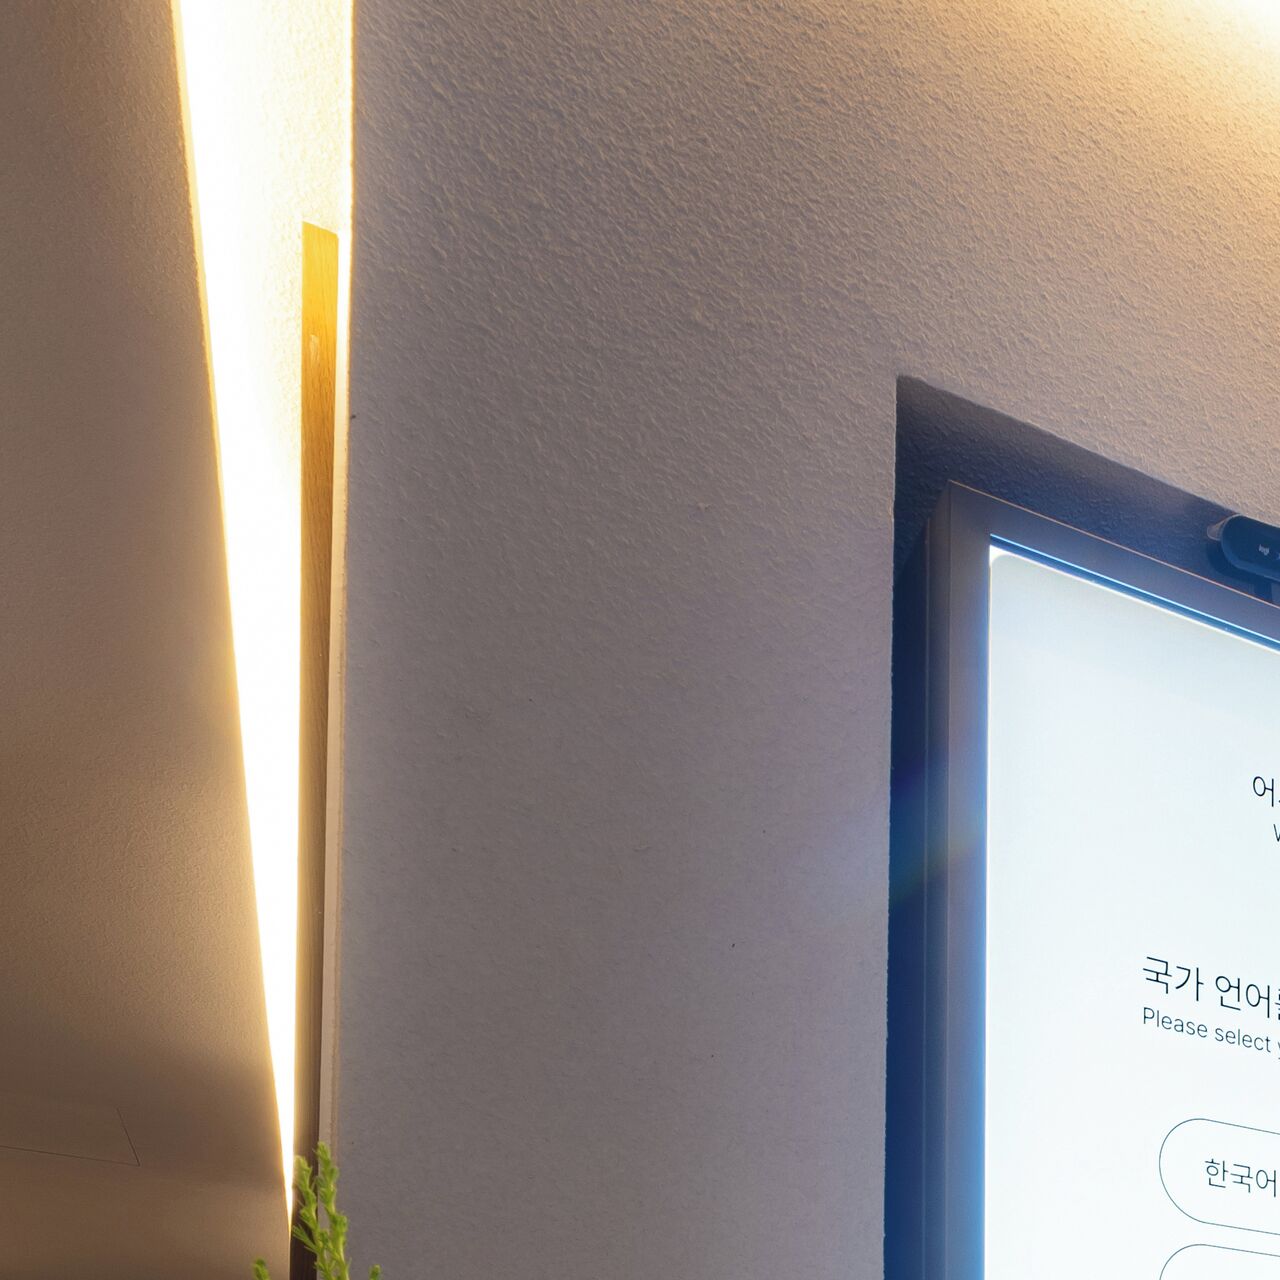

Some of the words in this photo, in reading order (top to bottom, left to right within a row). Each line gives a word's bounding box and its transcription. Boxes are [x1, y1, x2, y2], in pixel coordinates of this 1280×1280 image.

[1143, 956, 1204, 1002] 국가
[1143, 1006, 1208, 1038] Please
[1214, 1026, 1271, 1053] select
[1204, 1158, 1277, 1198] 한국어
